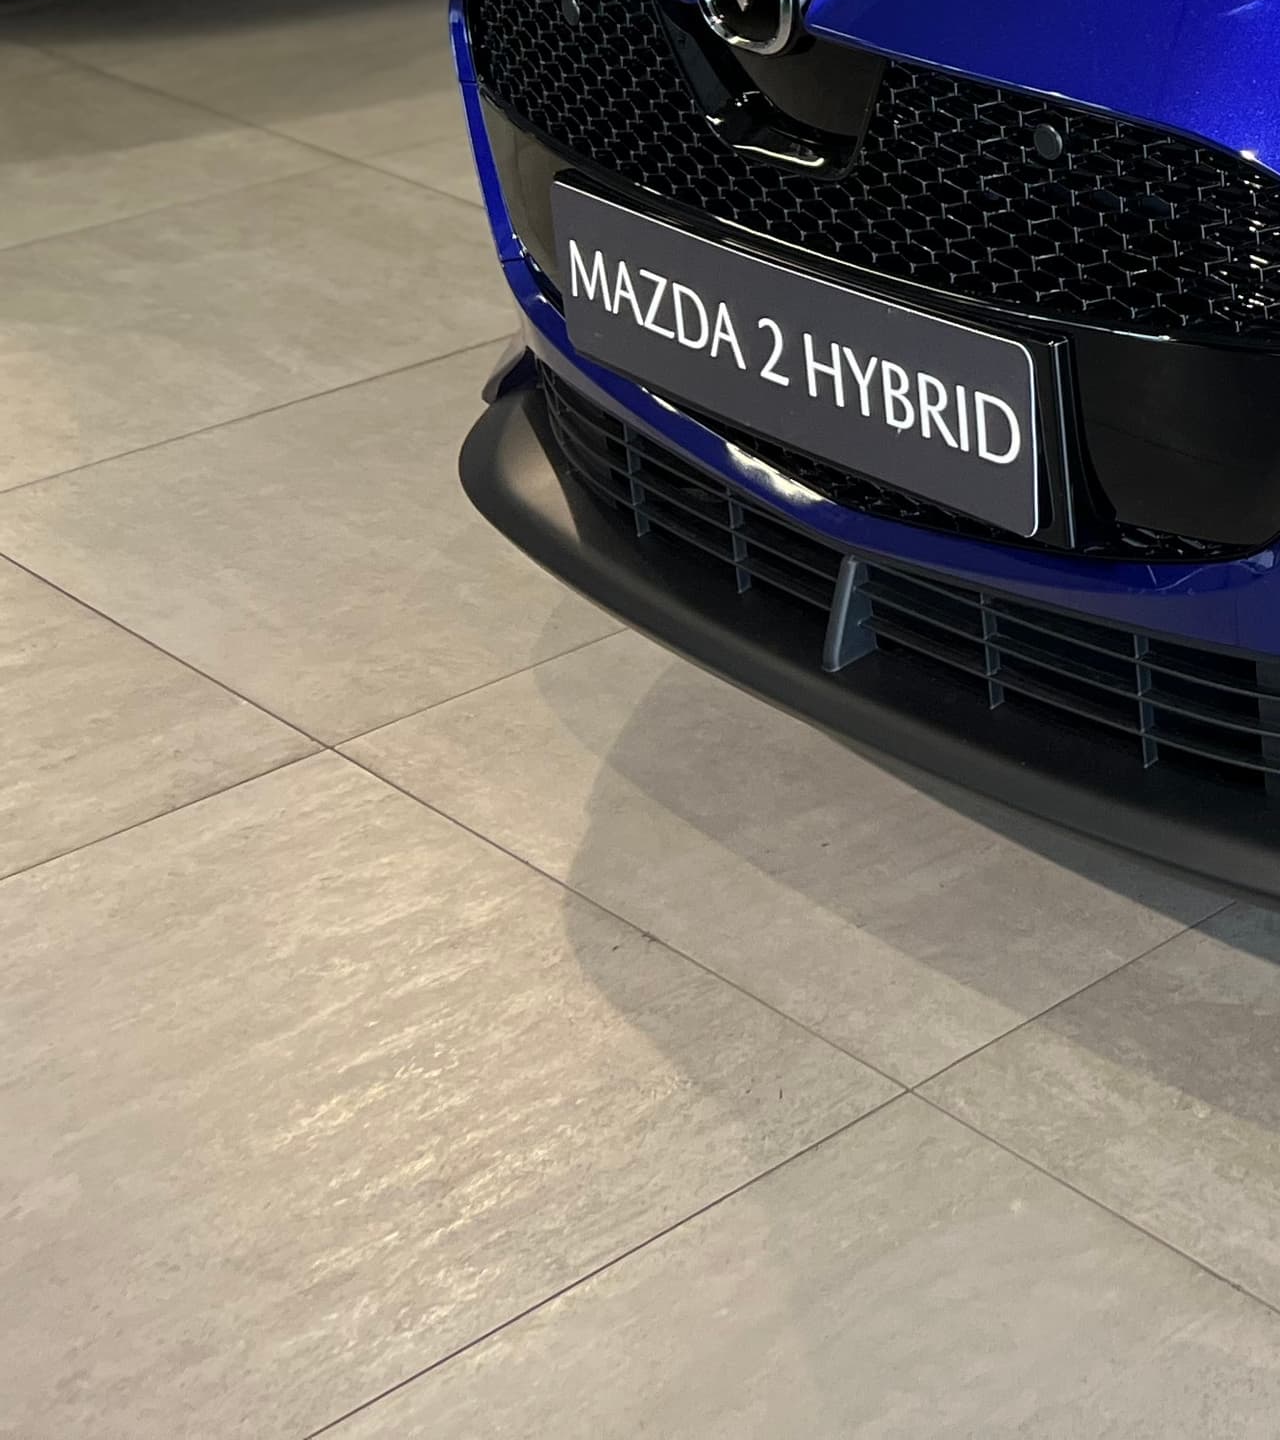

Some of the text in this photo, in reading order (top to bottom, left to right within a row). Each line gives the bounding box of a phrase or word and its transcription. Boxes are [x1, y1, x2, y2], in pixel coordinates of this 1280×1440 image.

[568, 239, 1021, 465] MAZDA 2 HYBRID
